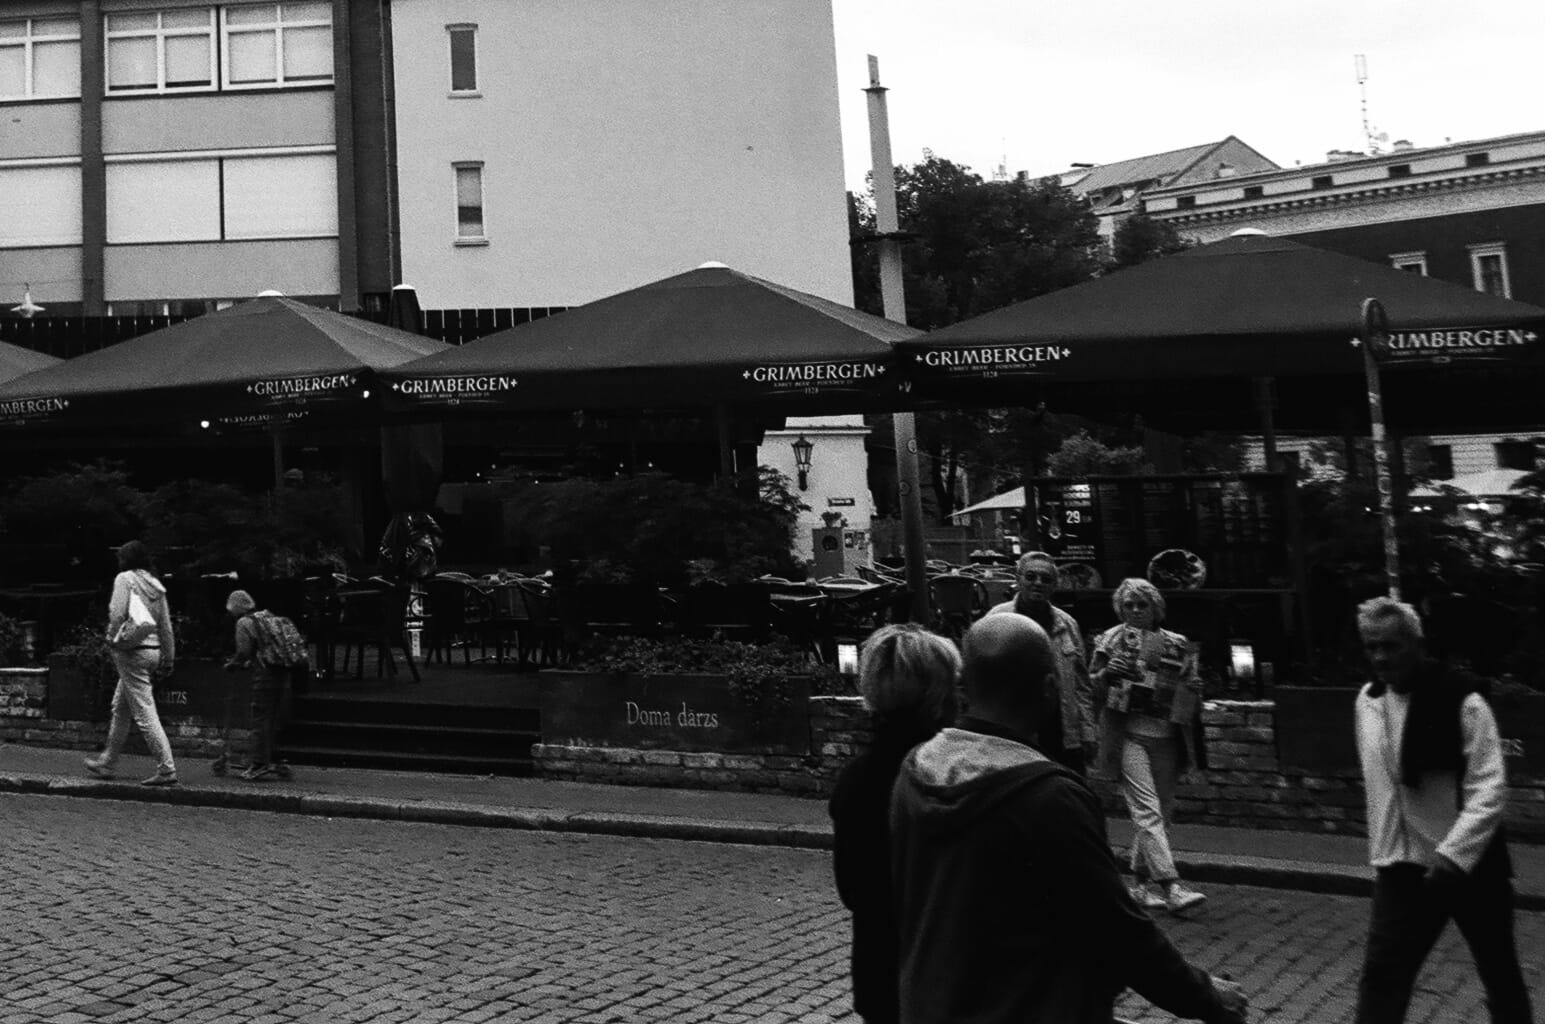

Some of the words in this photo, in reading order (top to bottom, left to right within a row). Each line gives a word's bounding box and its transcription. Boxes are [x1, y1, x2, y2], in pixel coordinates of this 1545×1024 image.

[1387, 328, 1525, 350] RIMBERGEN
[925, 346, 1061, 366] GRIMBERGEN
[753, 363, 876, 382] GRIMBERGEN
[253, 374, 351, 396] GRIMBERGEN
[400, 376, 510, 394] GRIMBERGEN
[1066, 510, 1081, 524] 29
[625, 701, 672, 726] Doma
[677, 701, 719, 728] dārzs
